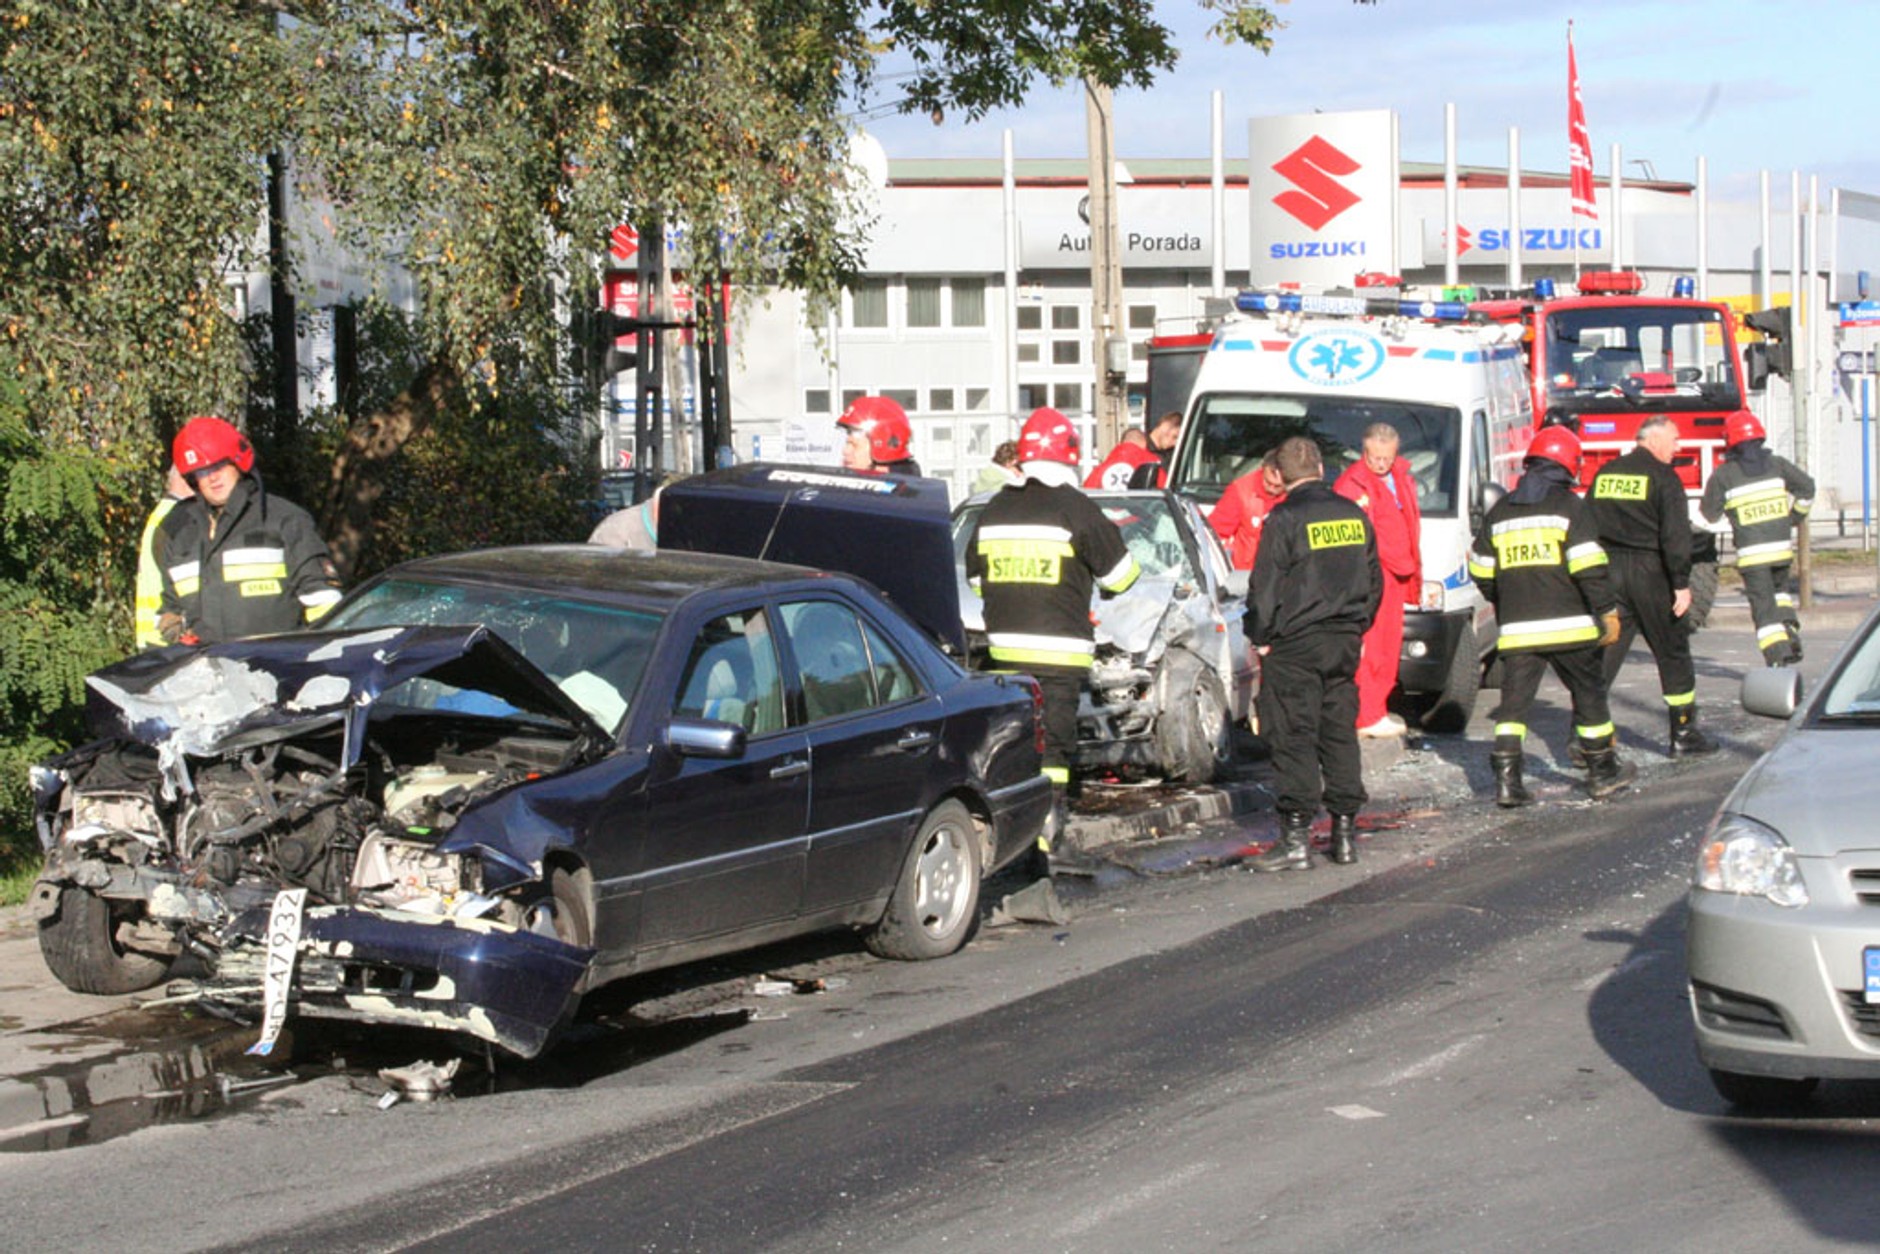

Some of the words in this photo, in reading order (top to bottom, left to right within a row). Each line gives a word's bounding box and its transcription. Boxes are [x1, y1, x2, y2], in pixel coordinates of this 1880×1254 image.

[1128, 232, 1201, 251] Porada
[1269, 241, 1366, 259] SUZUKI
[1311, 523, 1363, 546] POLICJA
